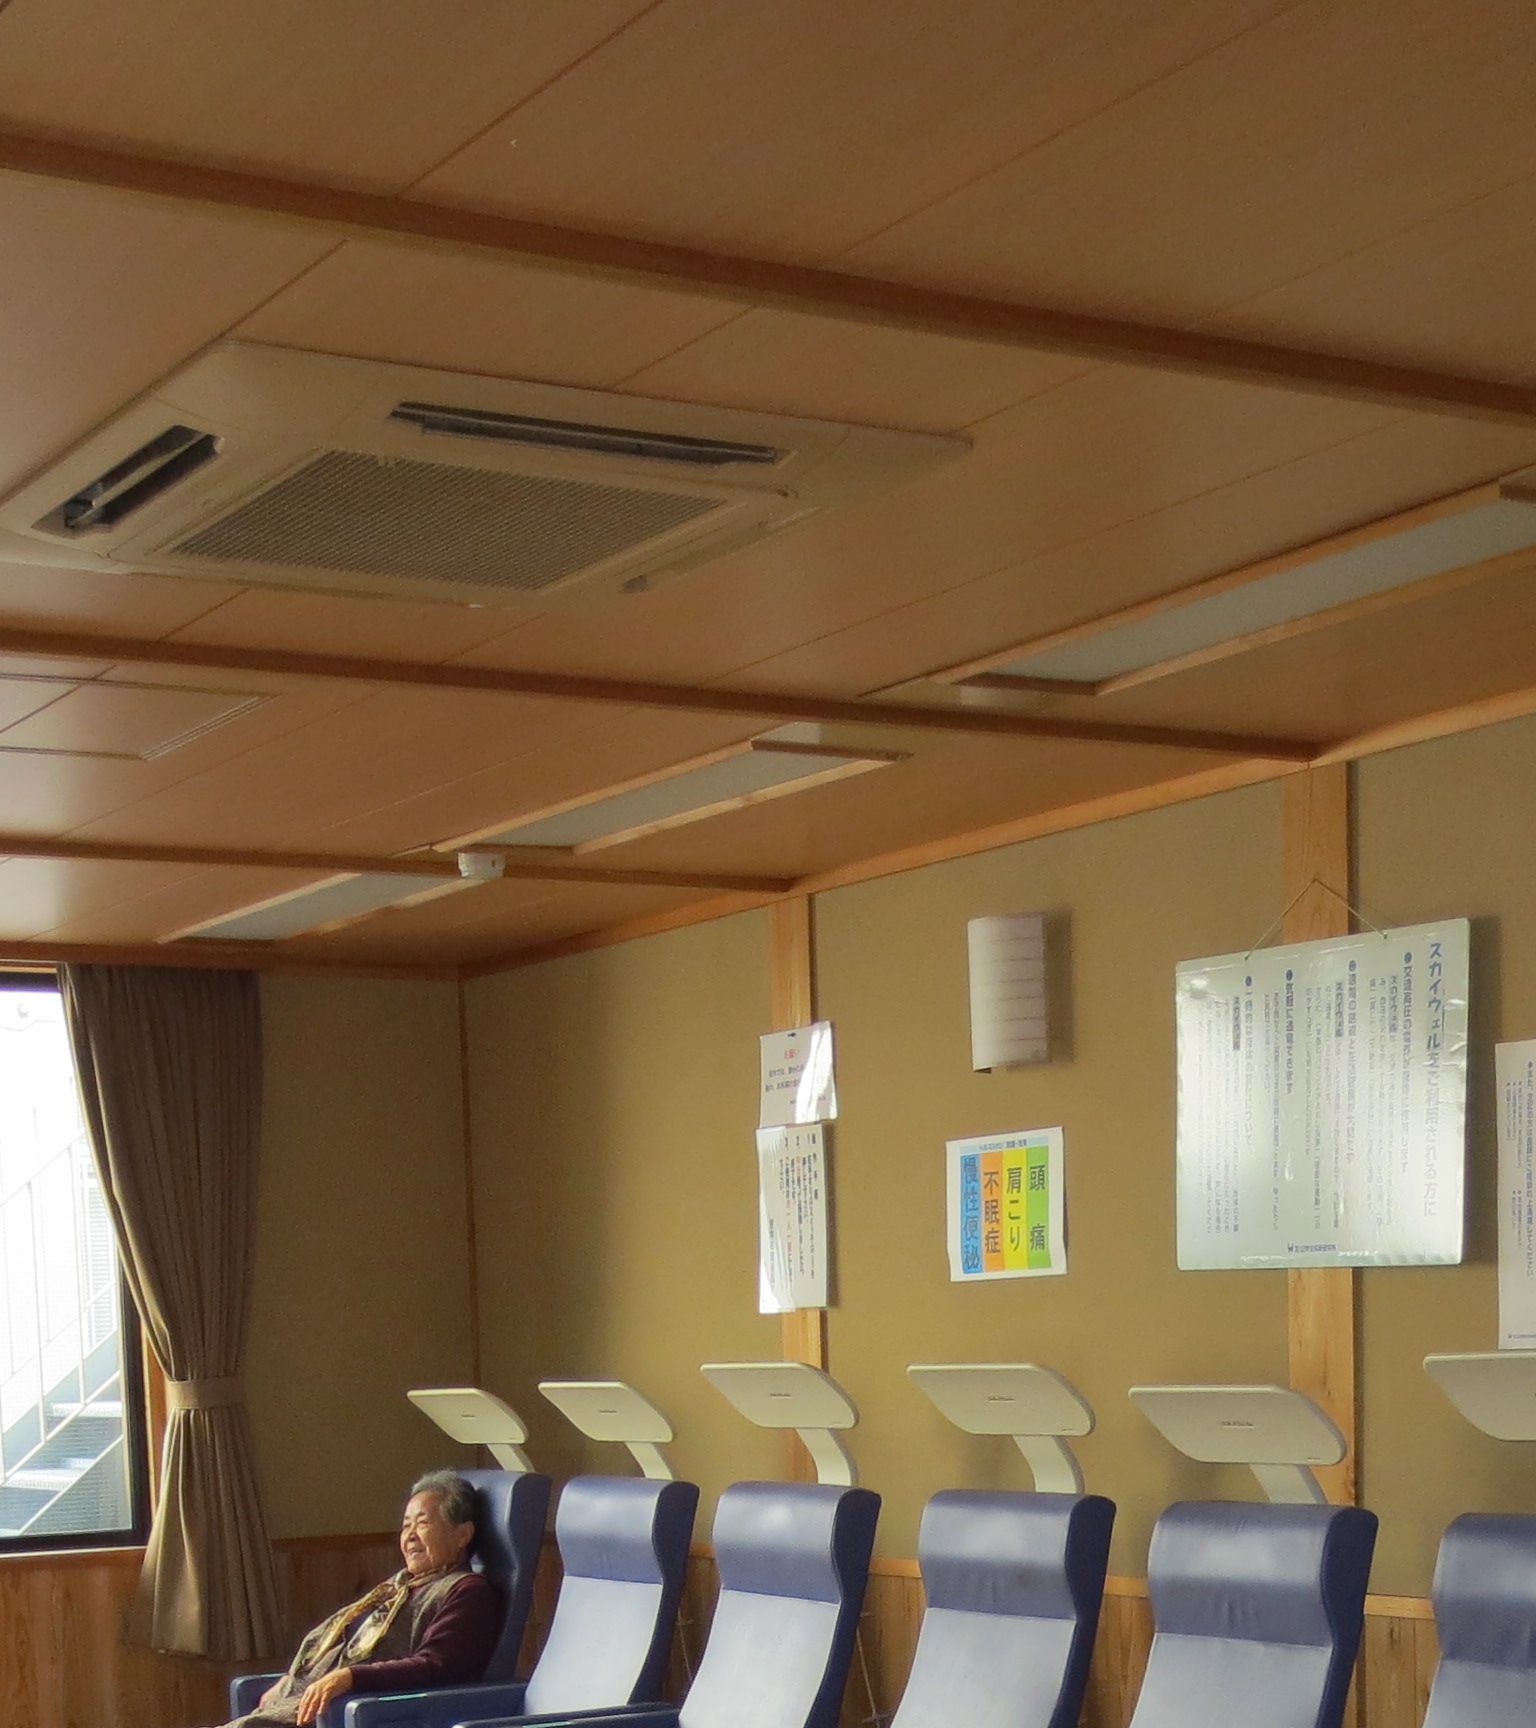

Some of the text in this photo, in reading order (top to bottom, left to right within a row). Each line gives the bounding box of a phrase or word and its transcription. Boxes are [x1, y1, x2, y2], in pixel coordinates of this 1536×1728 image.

[983, 1171, 1000, 1254] 不眠症
[1006, 1167, 1022, 1252] 肩こり
[1029, 1165, 1046, 1250] 頭痛
